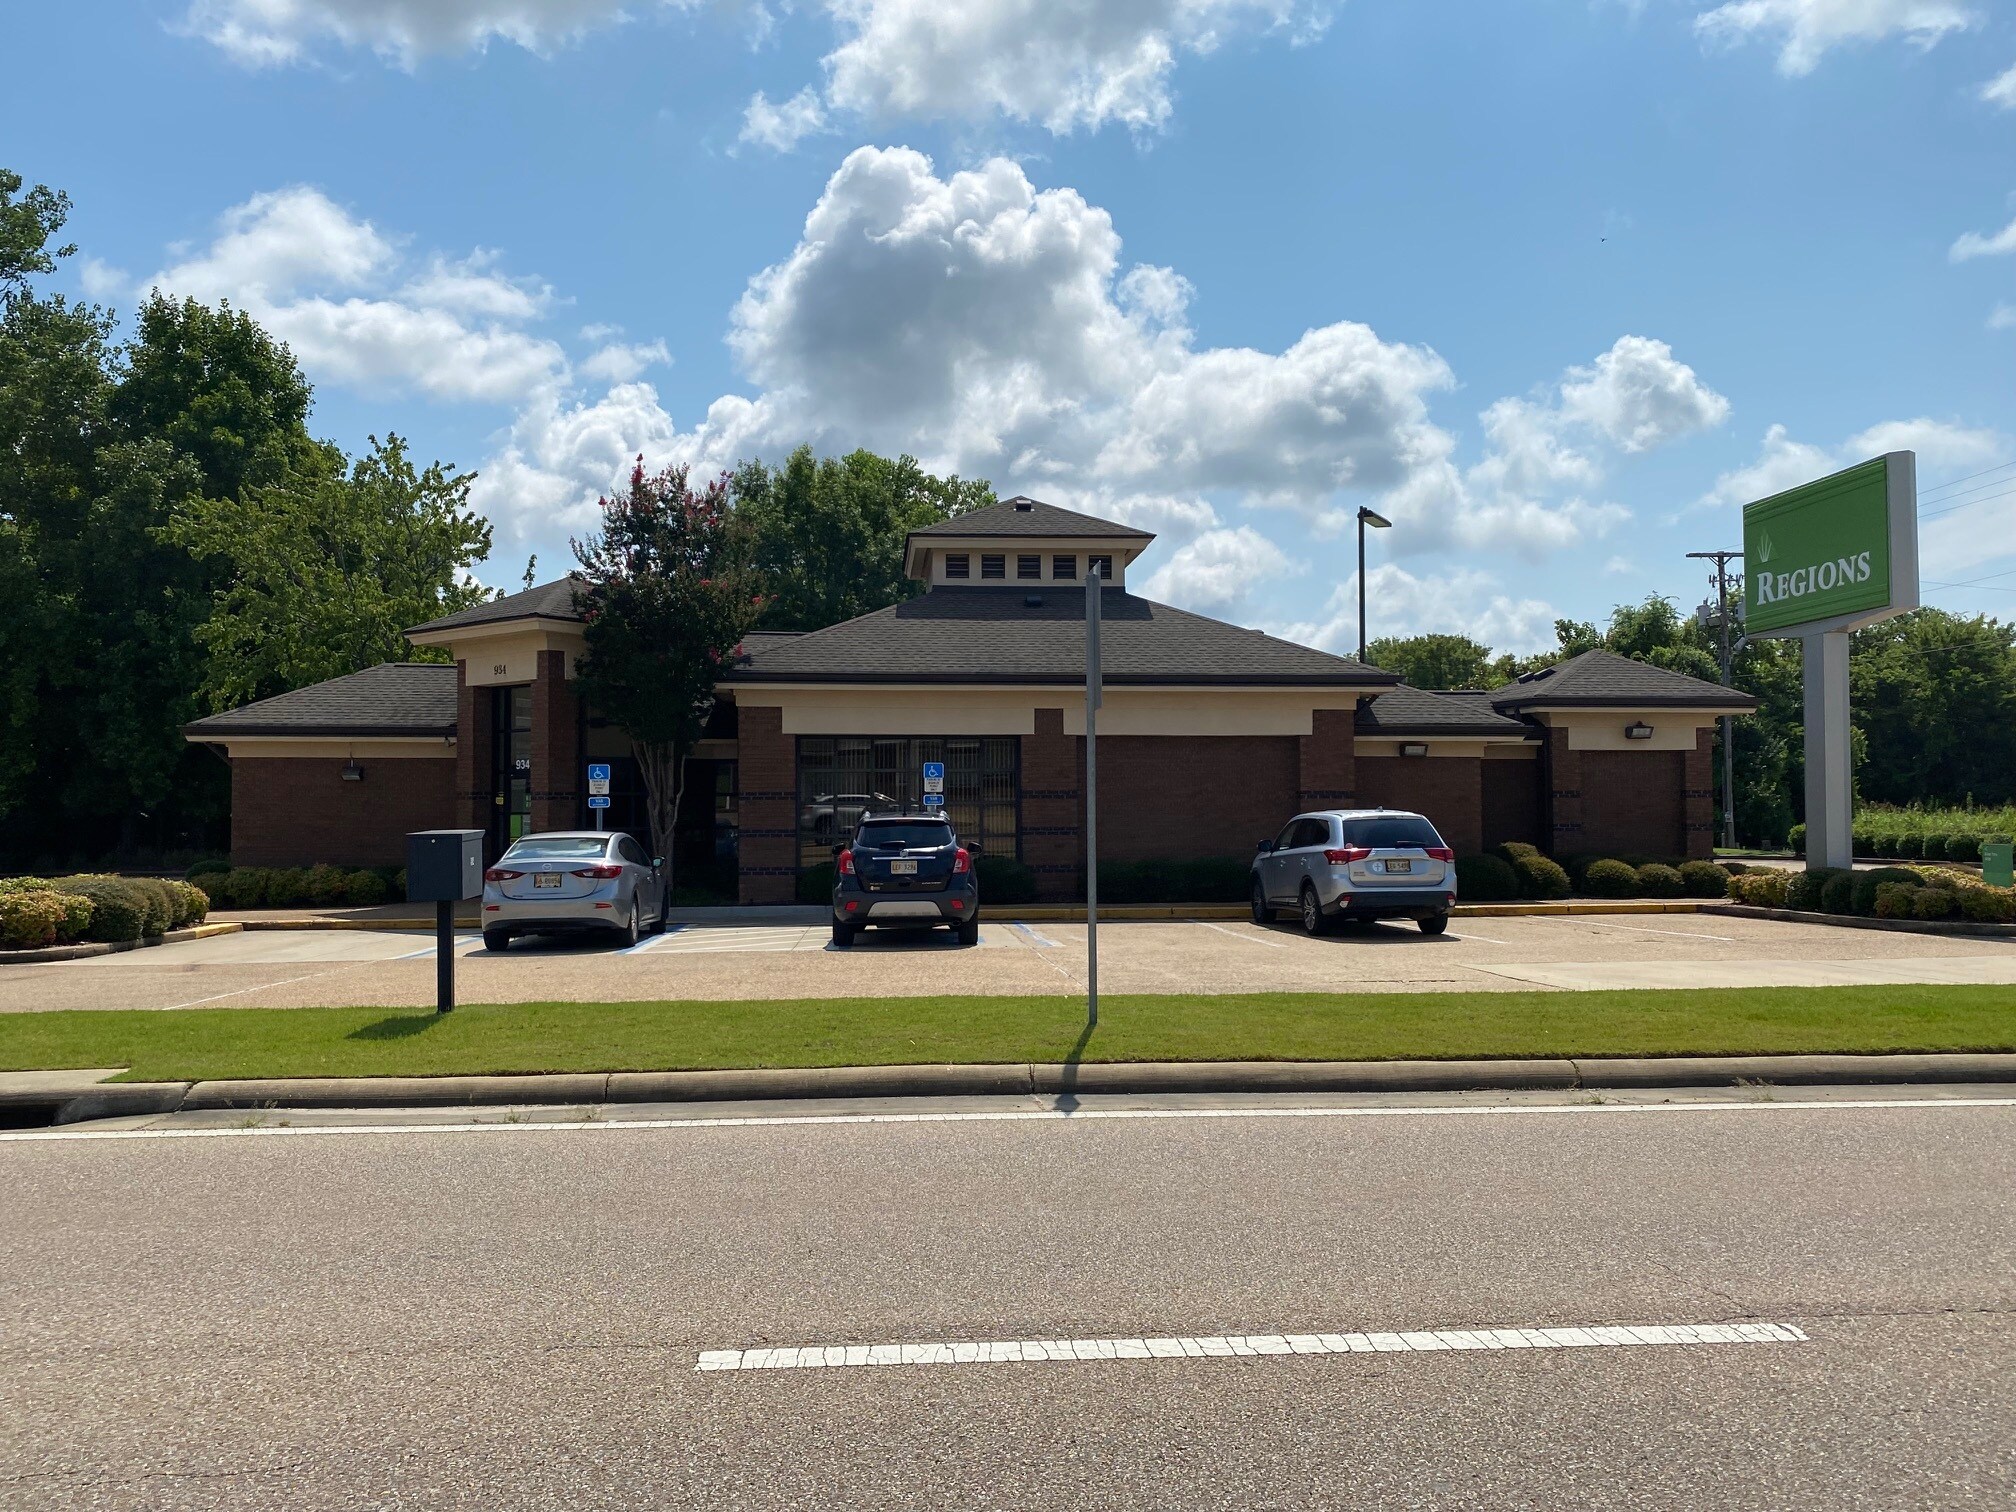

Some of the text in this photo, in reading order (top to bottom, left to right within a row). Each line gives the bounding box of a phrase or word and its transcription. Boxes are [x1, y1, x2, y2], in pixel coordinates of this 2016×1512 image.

[1756, 551, 1871, 606] REGIONS
[494, 665, 506, 675] 934
[516, 760, 530, 770] 934
